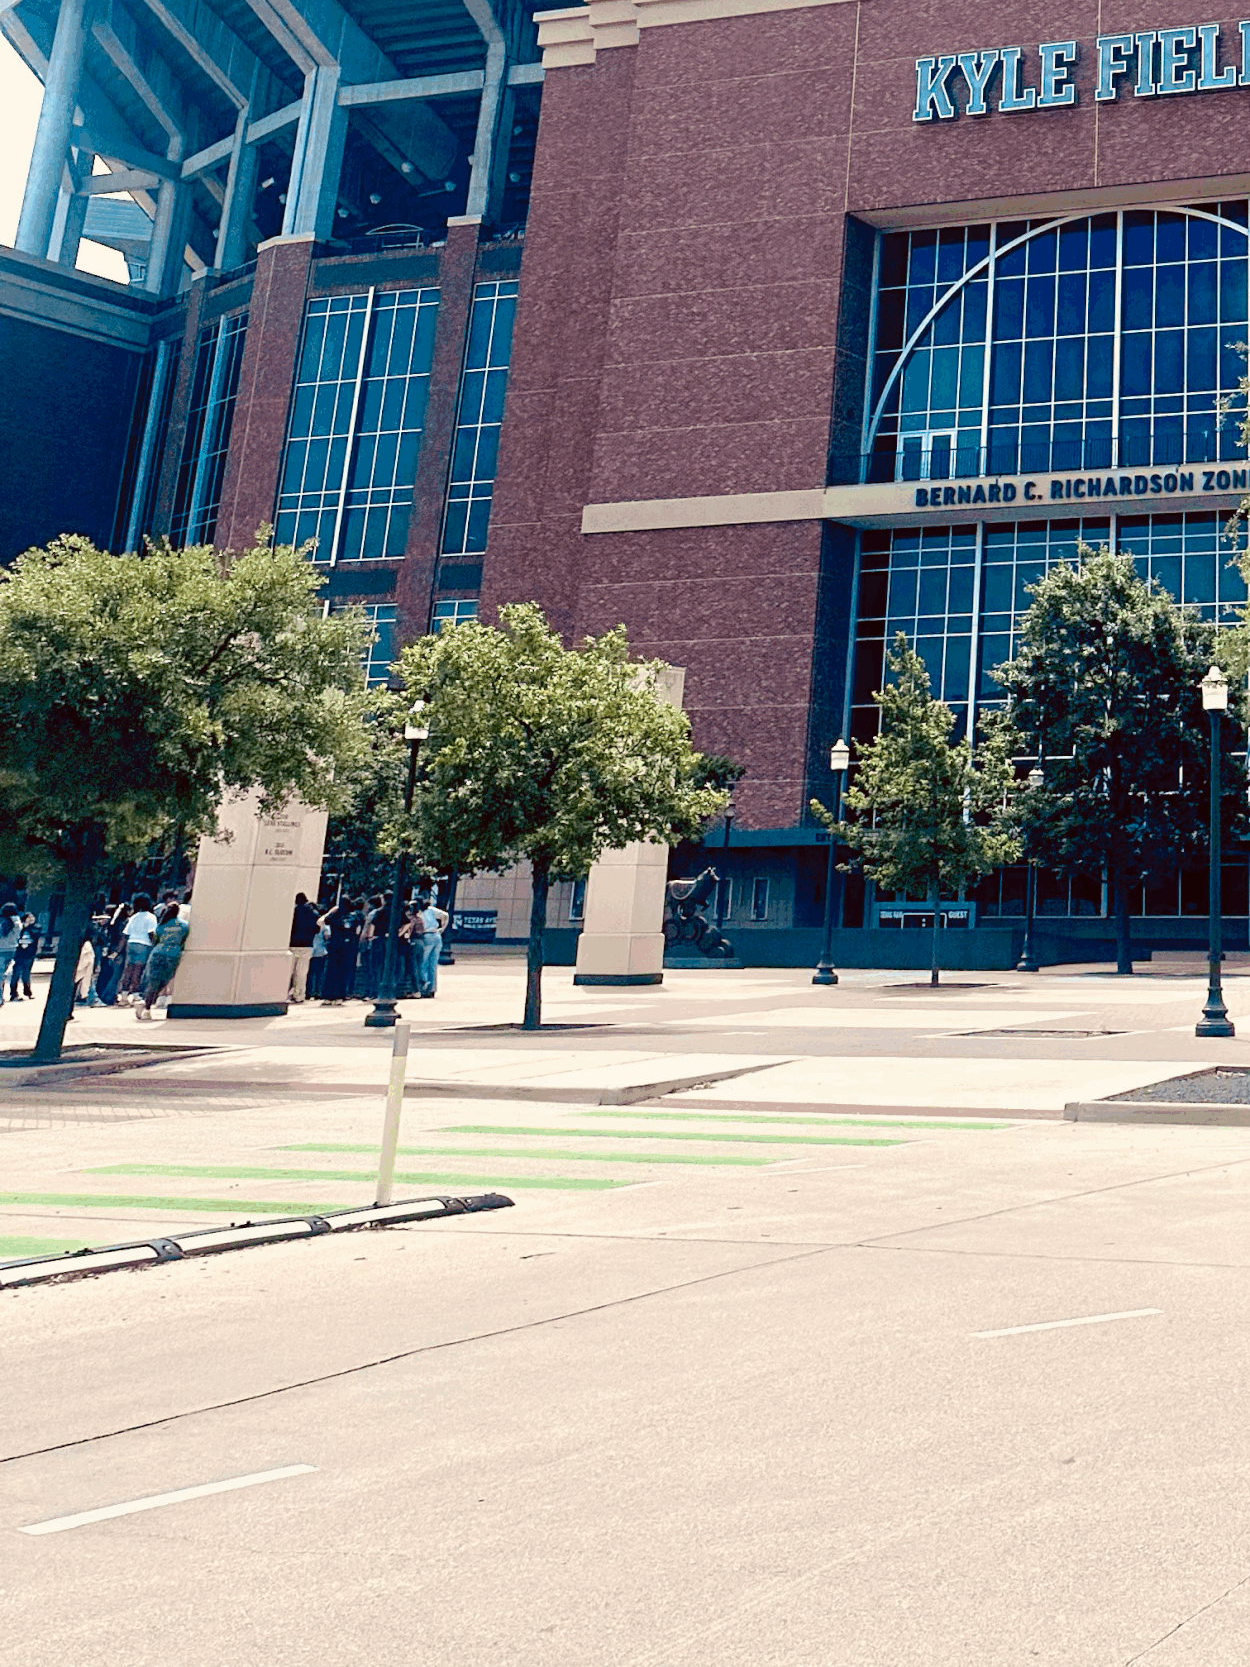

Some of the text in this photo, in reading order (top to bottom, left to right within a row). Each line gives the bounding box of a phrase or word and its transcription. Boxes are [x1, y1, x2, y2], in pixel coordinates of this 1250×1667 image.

[912, 40, 1077, 122] KYLE
[915, 482, 1016, 507] BERNARD
[1024, 481, 1043, 501] C.
[1050, 471, 1194, 500] RICHARDSON
